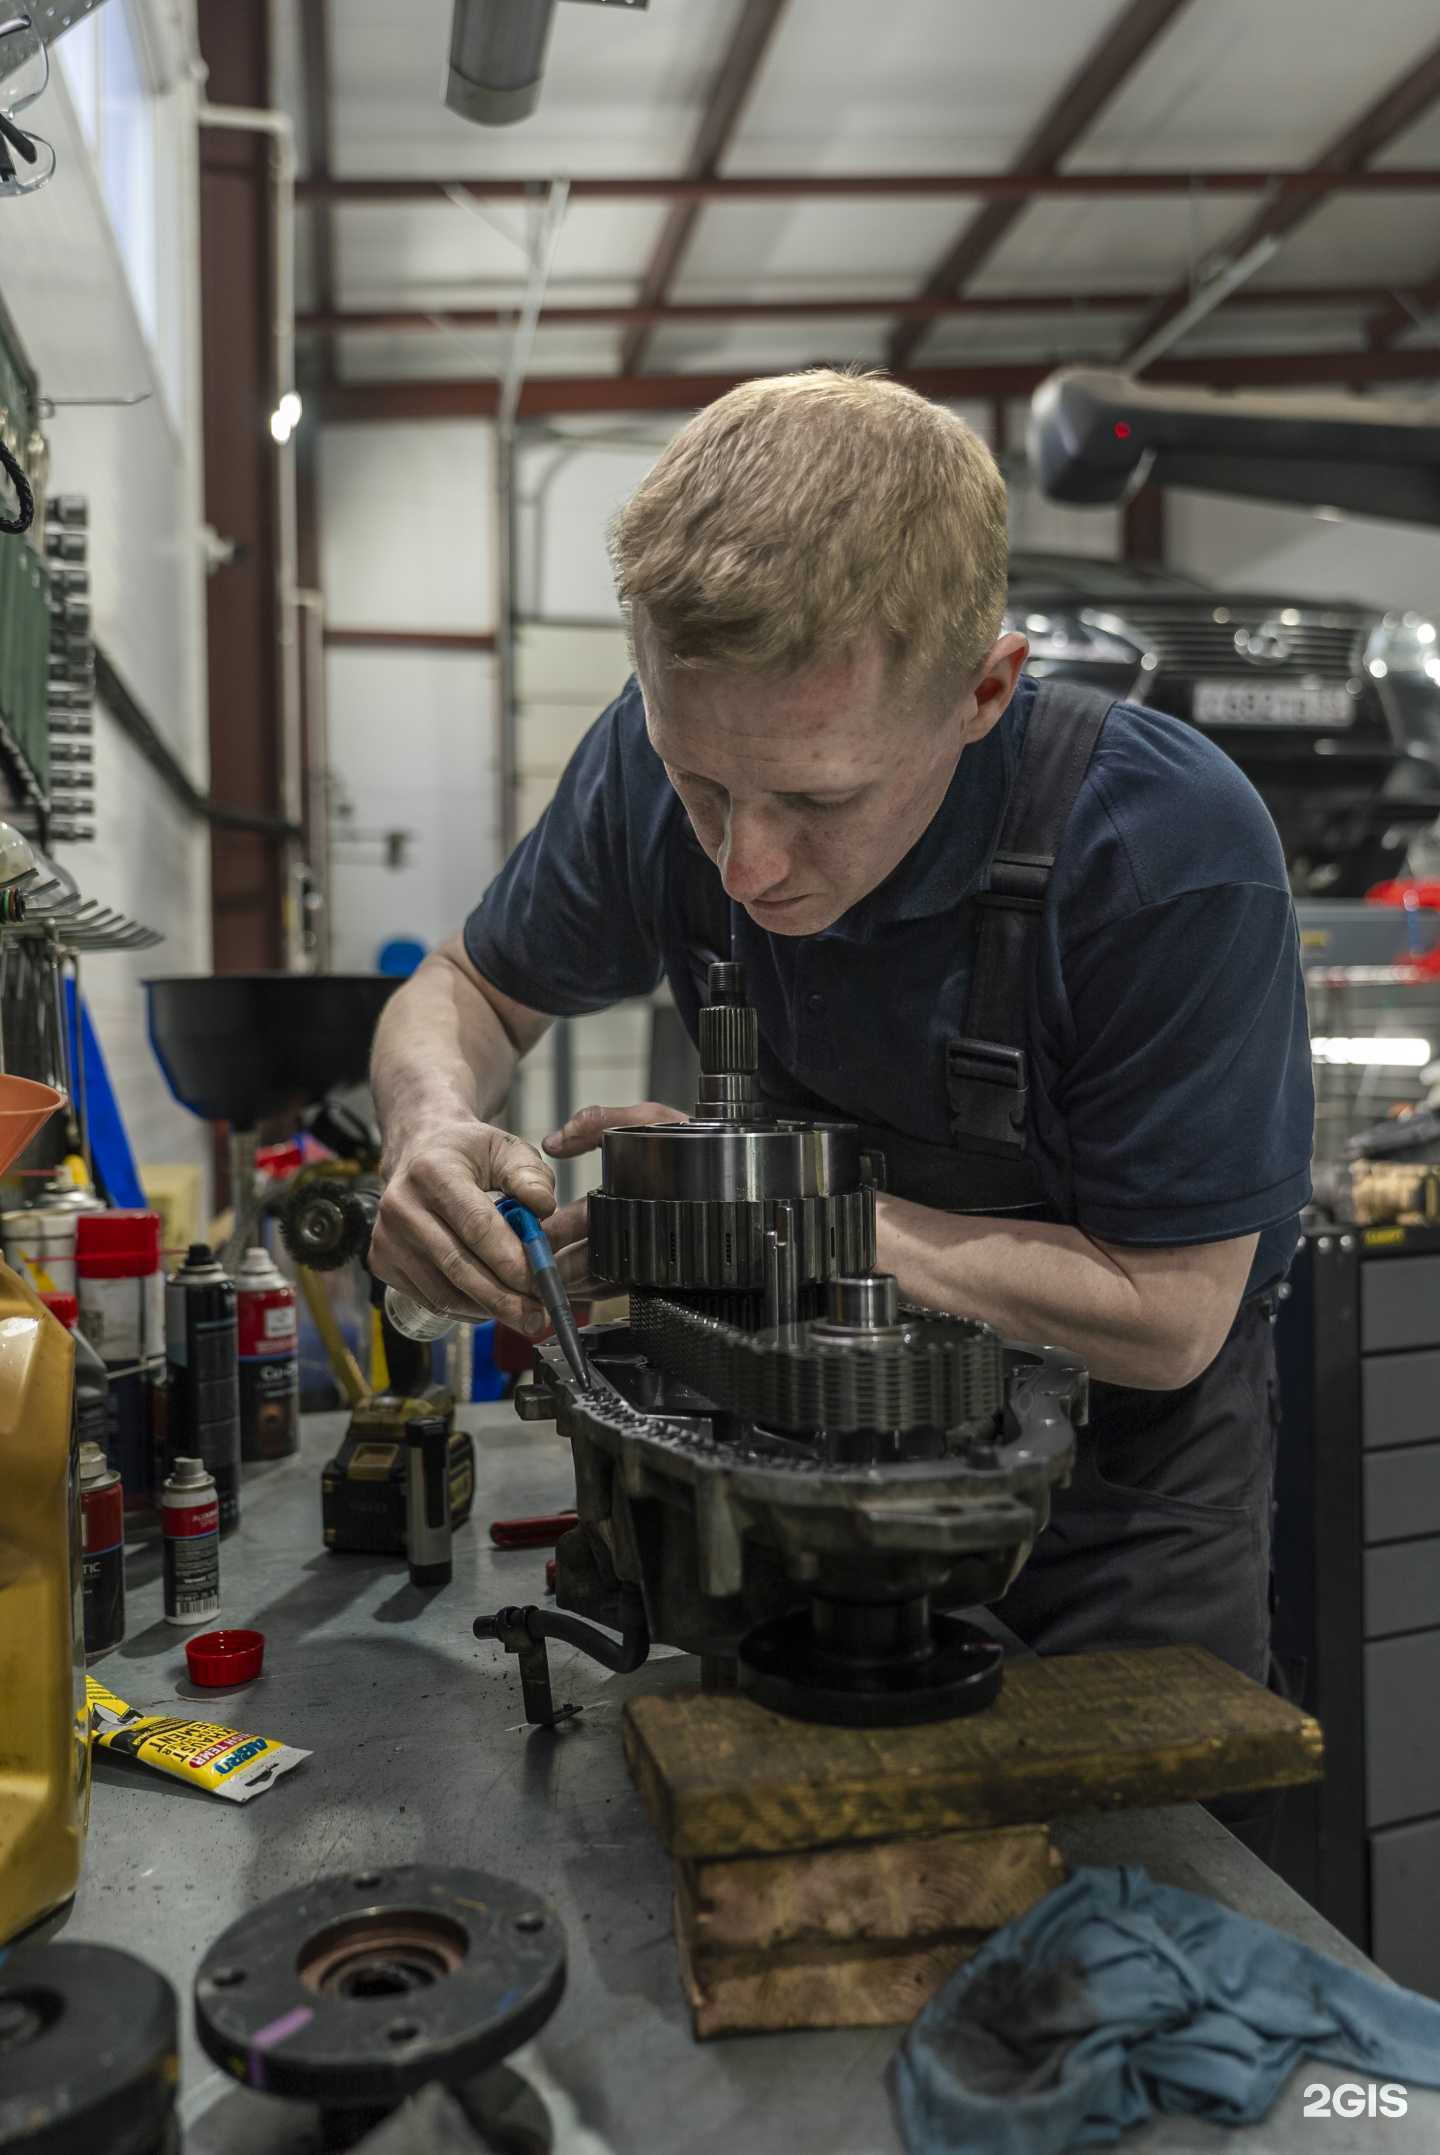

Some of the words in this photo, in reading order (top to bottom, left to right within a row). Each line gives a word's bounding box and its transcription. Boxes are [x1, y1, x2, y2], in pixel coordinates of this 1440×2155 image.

[148, 1721, 209, 1753] EMENT
[172, 1727, 232, 1763] XHAUST
[213, 1735, 269, 1775] ABRO
